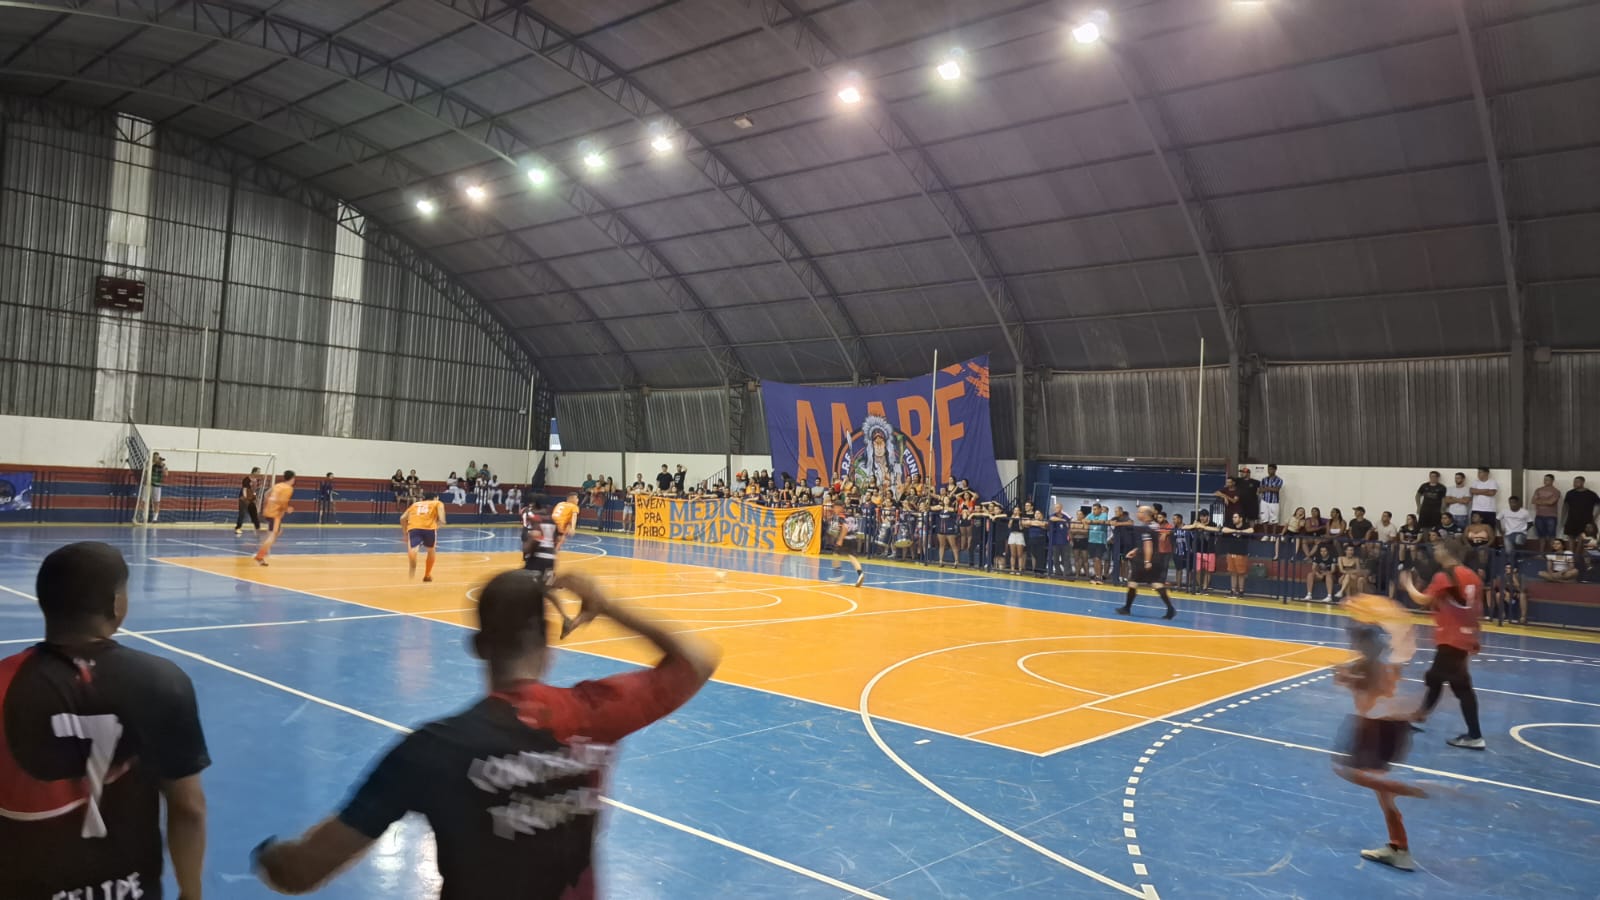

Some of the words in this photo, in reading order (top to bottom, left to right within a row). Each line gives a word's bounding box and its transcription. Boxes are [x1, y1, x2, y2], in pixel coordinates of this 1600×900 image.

[637, 498, 666, 509] #VEM
[670, 498, 777, 528] MEDICINA
[644, 512, 662, 523] PRA
[637, 523, 666, 537] TRIBO
[670, 520, 776, 550] PENAPOLIS
[51, 713, 124, 839] 7
